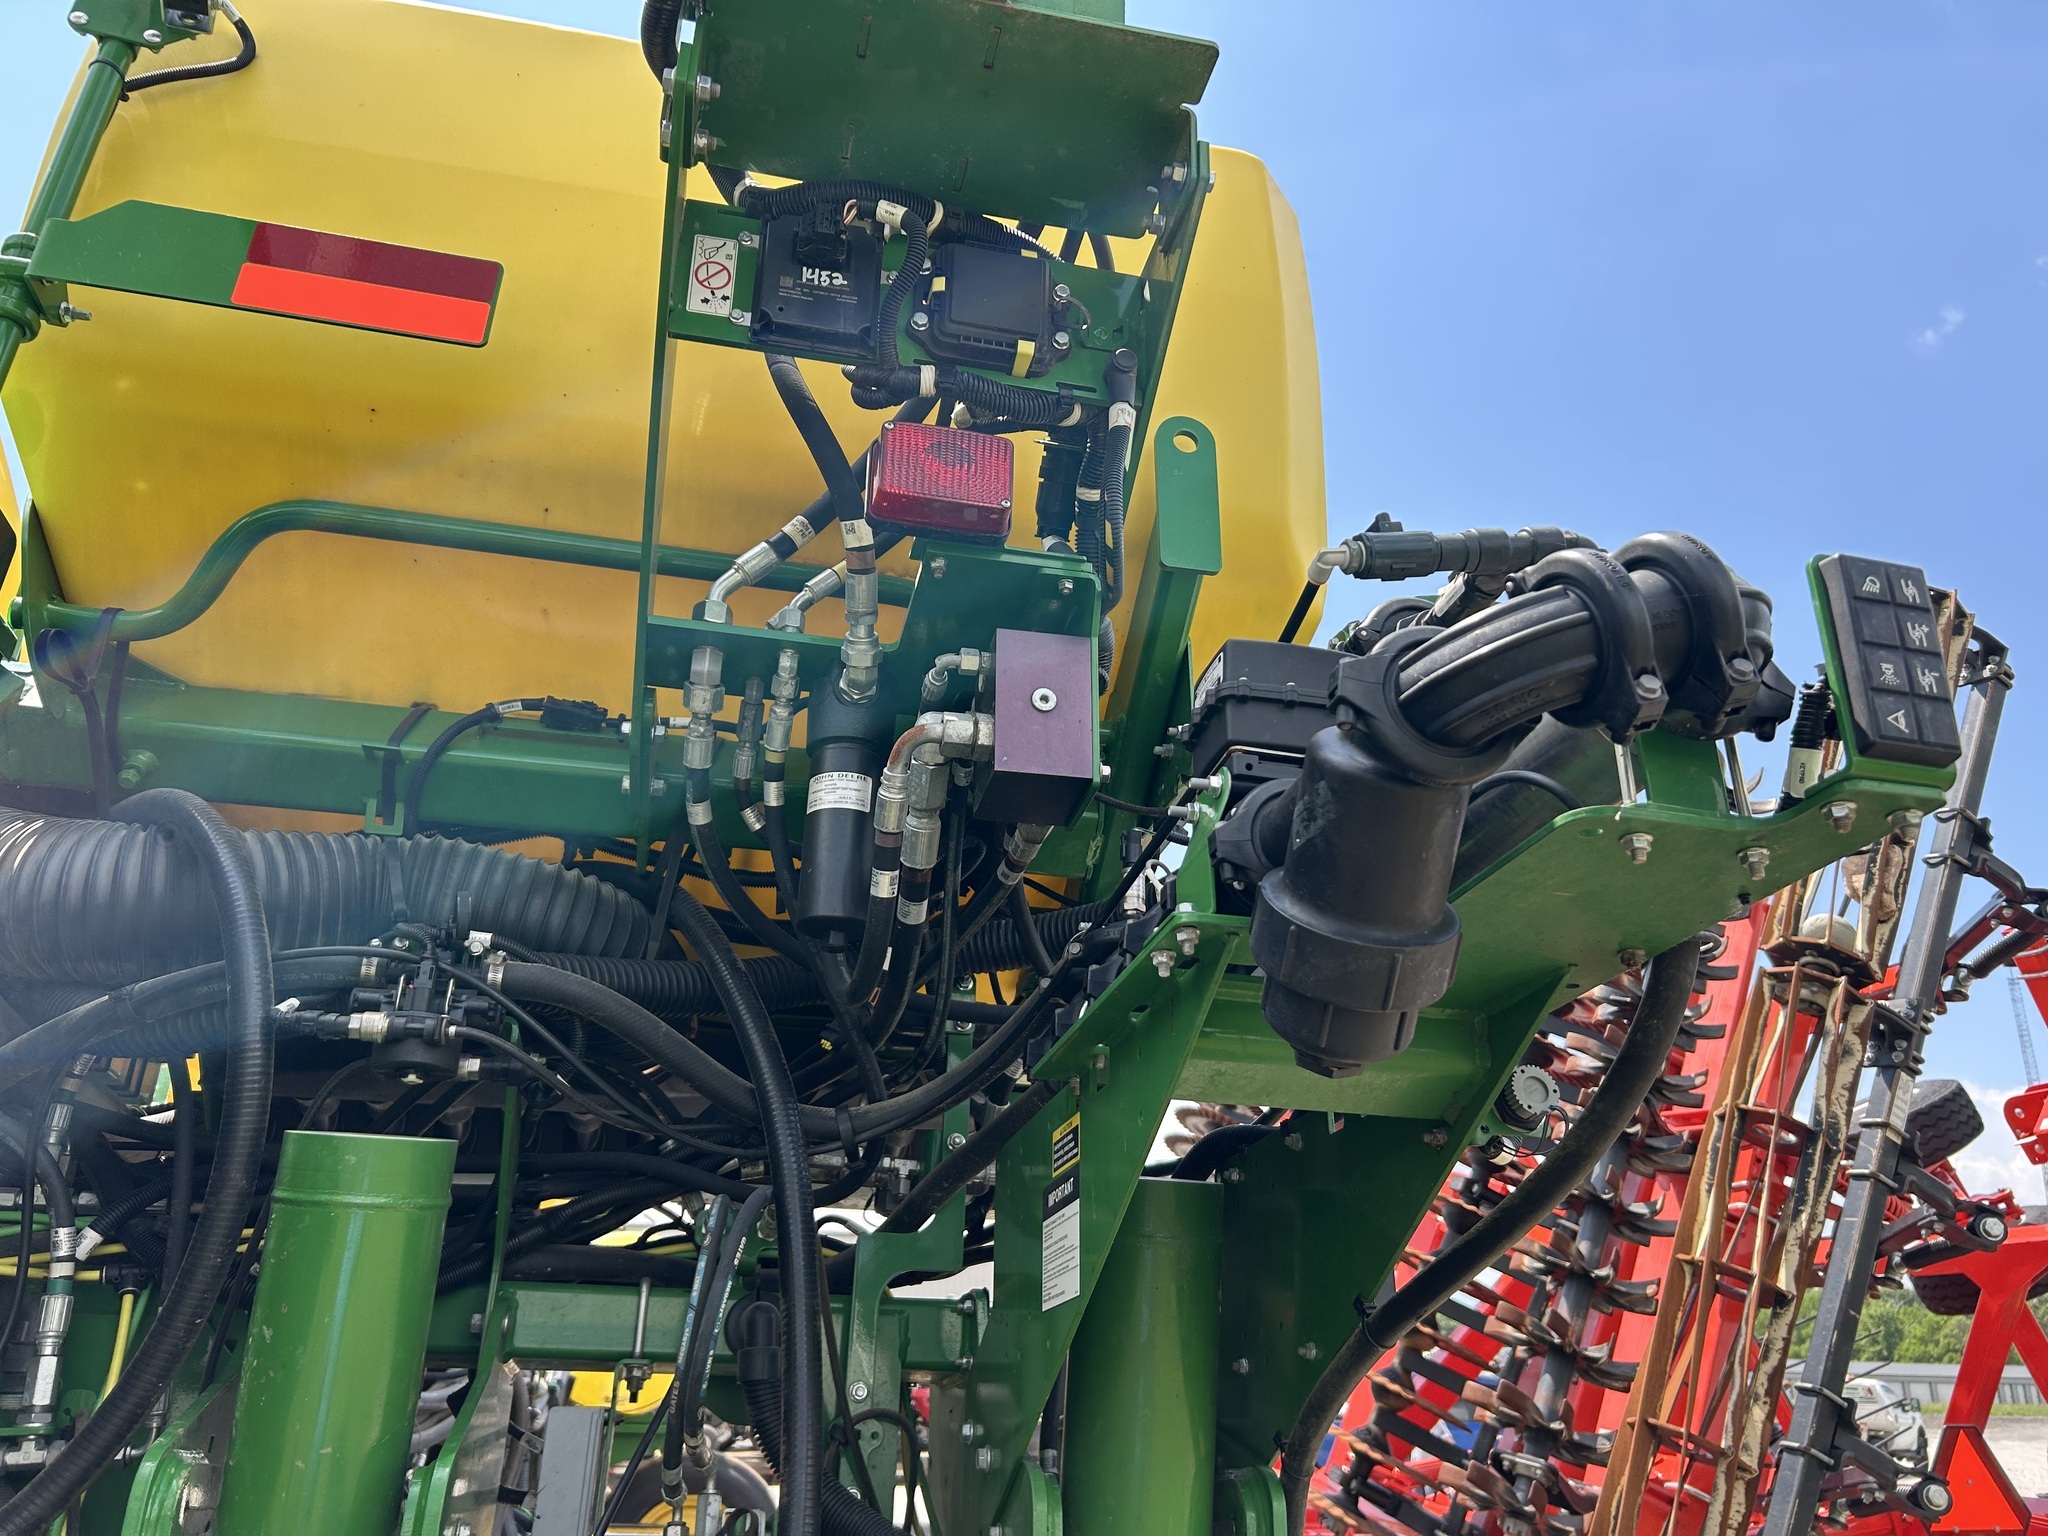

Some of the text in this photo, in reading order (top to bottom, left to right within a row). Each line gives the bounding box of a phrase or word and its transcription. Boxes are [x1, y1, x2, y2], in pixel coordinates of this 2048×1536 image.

[802, 266, 848, 286] 1452
[813, 773, 834, 783] JOHN
[837, 773, 867, 781] DEERE
[1798, 762, 1806, 784] KEYPAD
[1048, 1177, 1074, 1208] IMPORTANT
[734, 1236, 747, 1267] GATES
[669, 1380, 681, 1414] GATES
